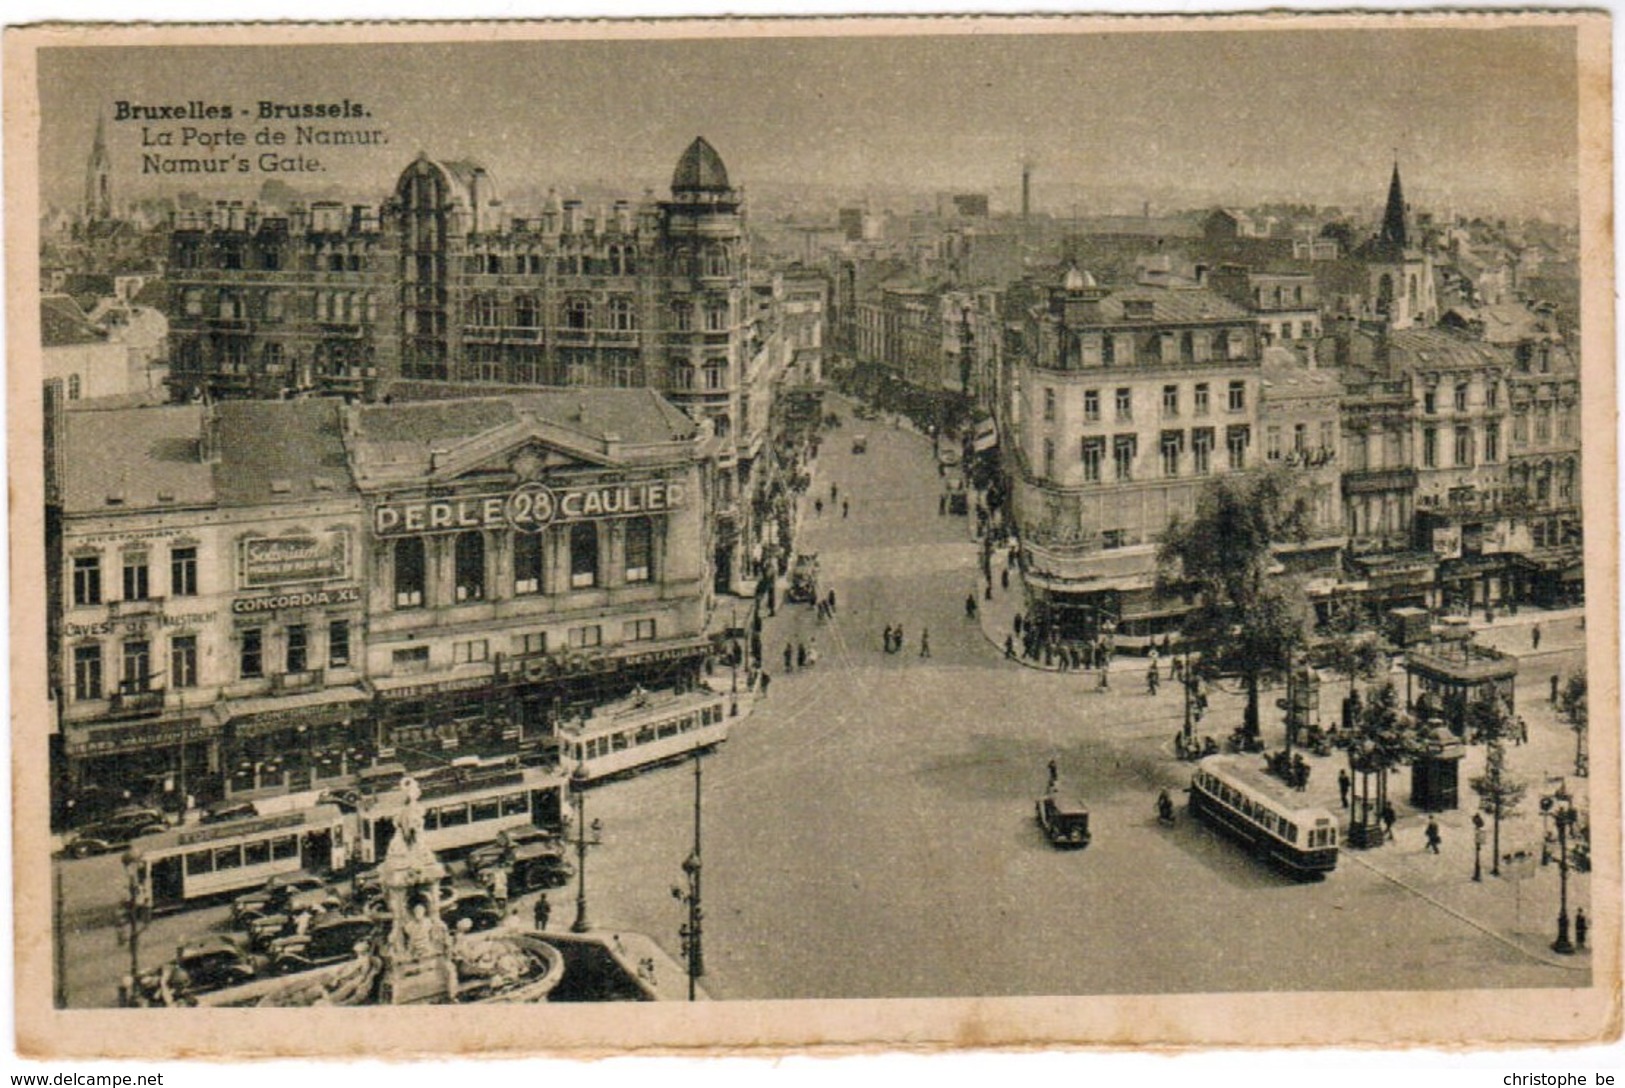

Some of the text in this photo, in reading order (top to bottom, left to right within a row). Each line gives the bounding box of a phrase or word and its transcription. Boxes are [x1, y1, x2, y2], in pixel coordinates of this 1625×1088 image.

[376, 485, 685, 533] PERLE 28 CAULIER
[234, 588, 359, 613] CONCORDIA XL
